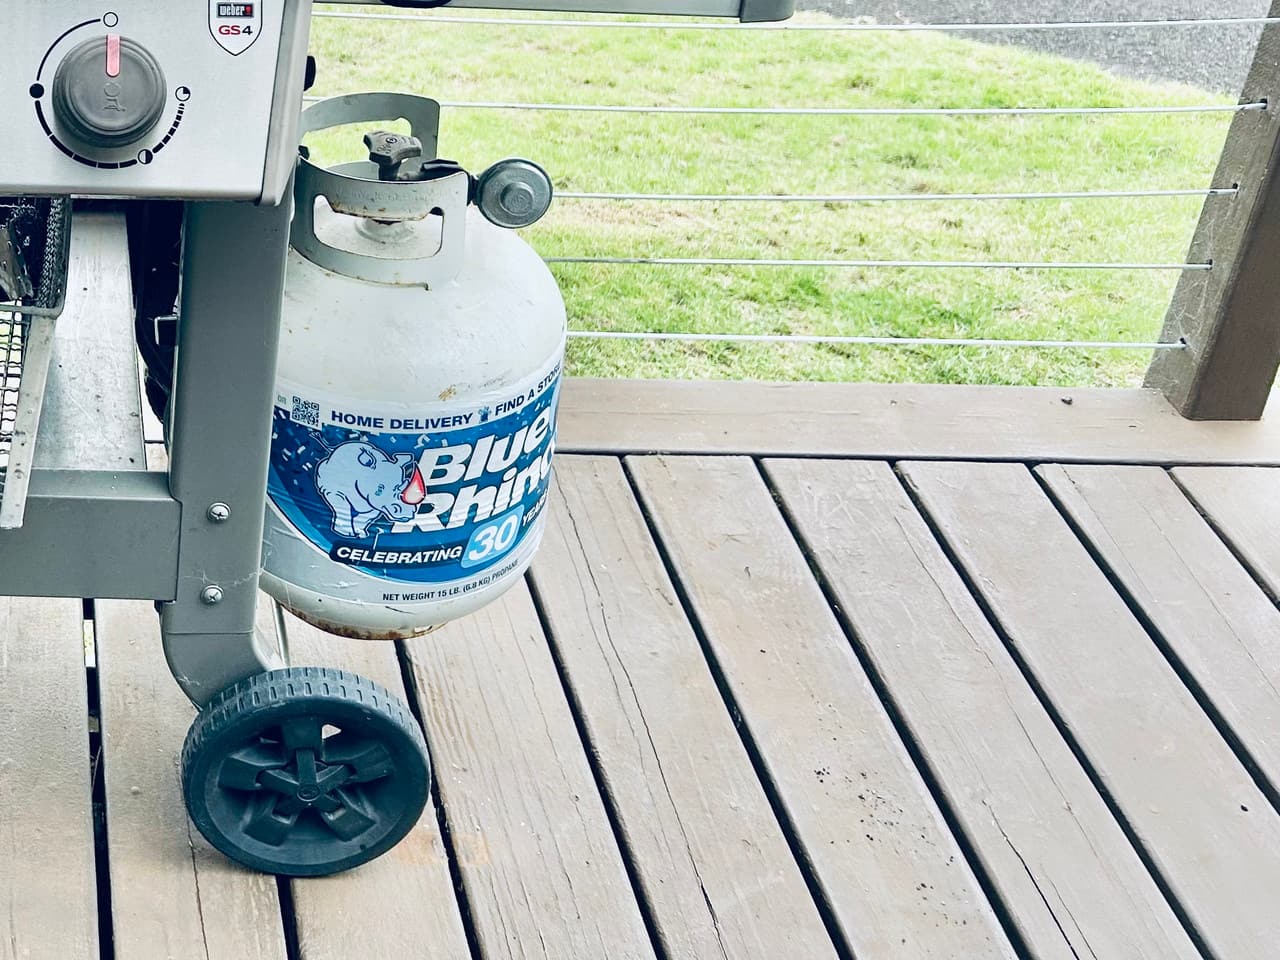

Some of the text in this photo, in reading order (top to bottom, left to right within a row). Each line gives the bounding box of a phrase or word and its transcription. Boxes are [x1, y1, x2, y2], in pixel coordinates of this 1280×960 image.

[219, 3, 246, 16] weber
[218, 24, 254, 36] GS4
[331, 409, 384, 429] HOME
[389, 412, 474, 430] DELIVERY
[494, 394, 525, 417] FIND
[527, 388, 535, 402] A
[418, 406, 552, 486] Blue
[336, 545, 464, 565] CELEBRATING
[469, 513, 519, 561] 30
[382, 592, 400, 602] NET
[402, 590, 435, 602] WEIGHT
[437, 589, 448, 598] 15
[449, 587, 461, 596] LB.
[478, 576, 491, 590] KG)
